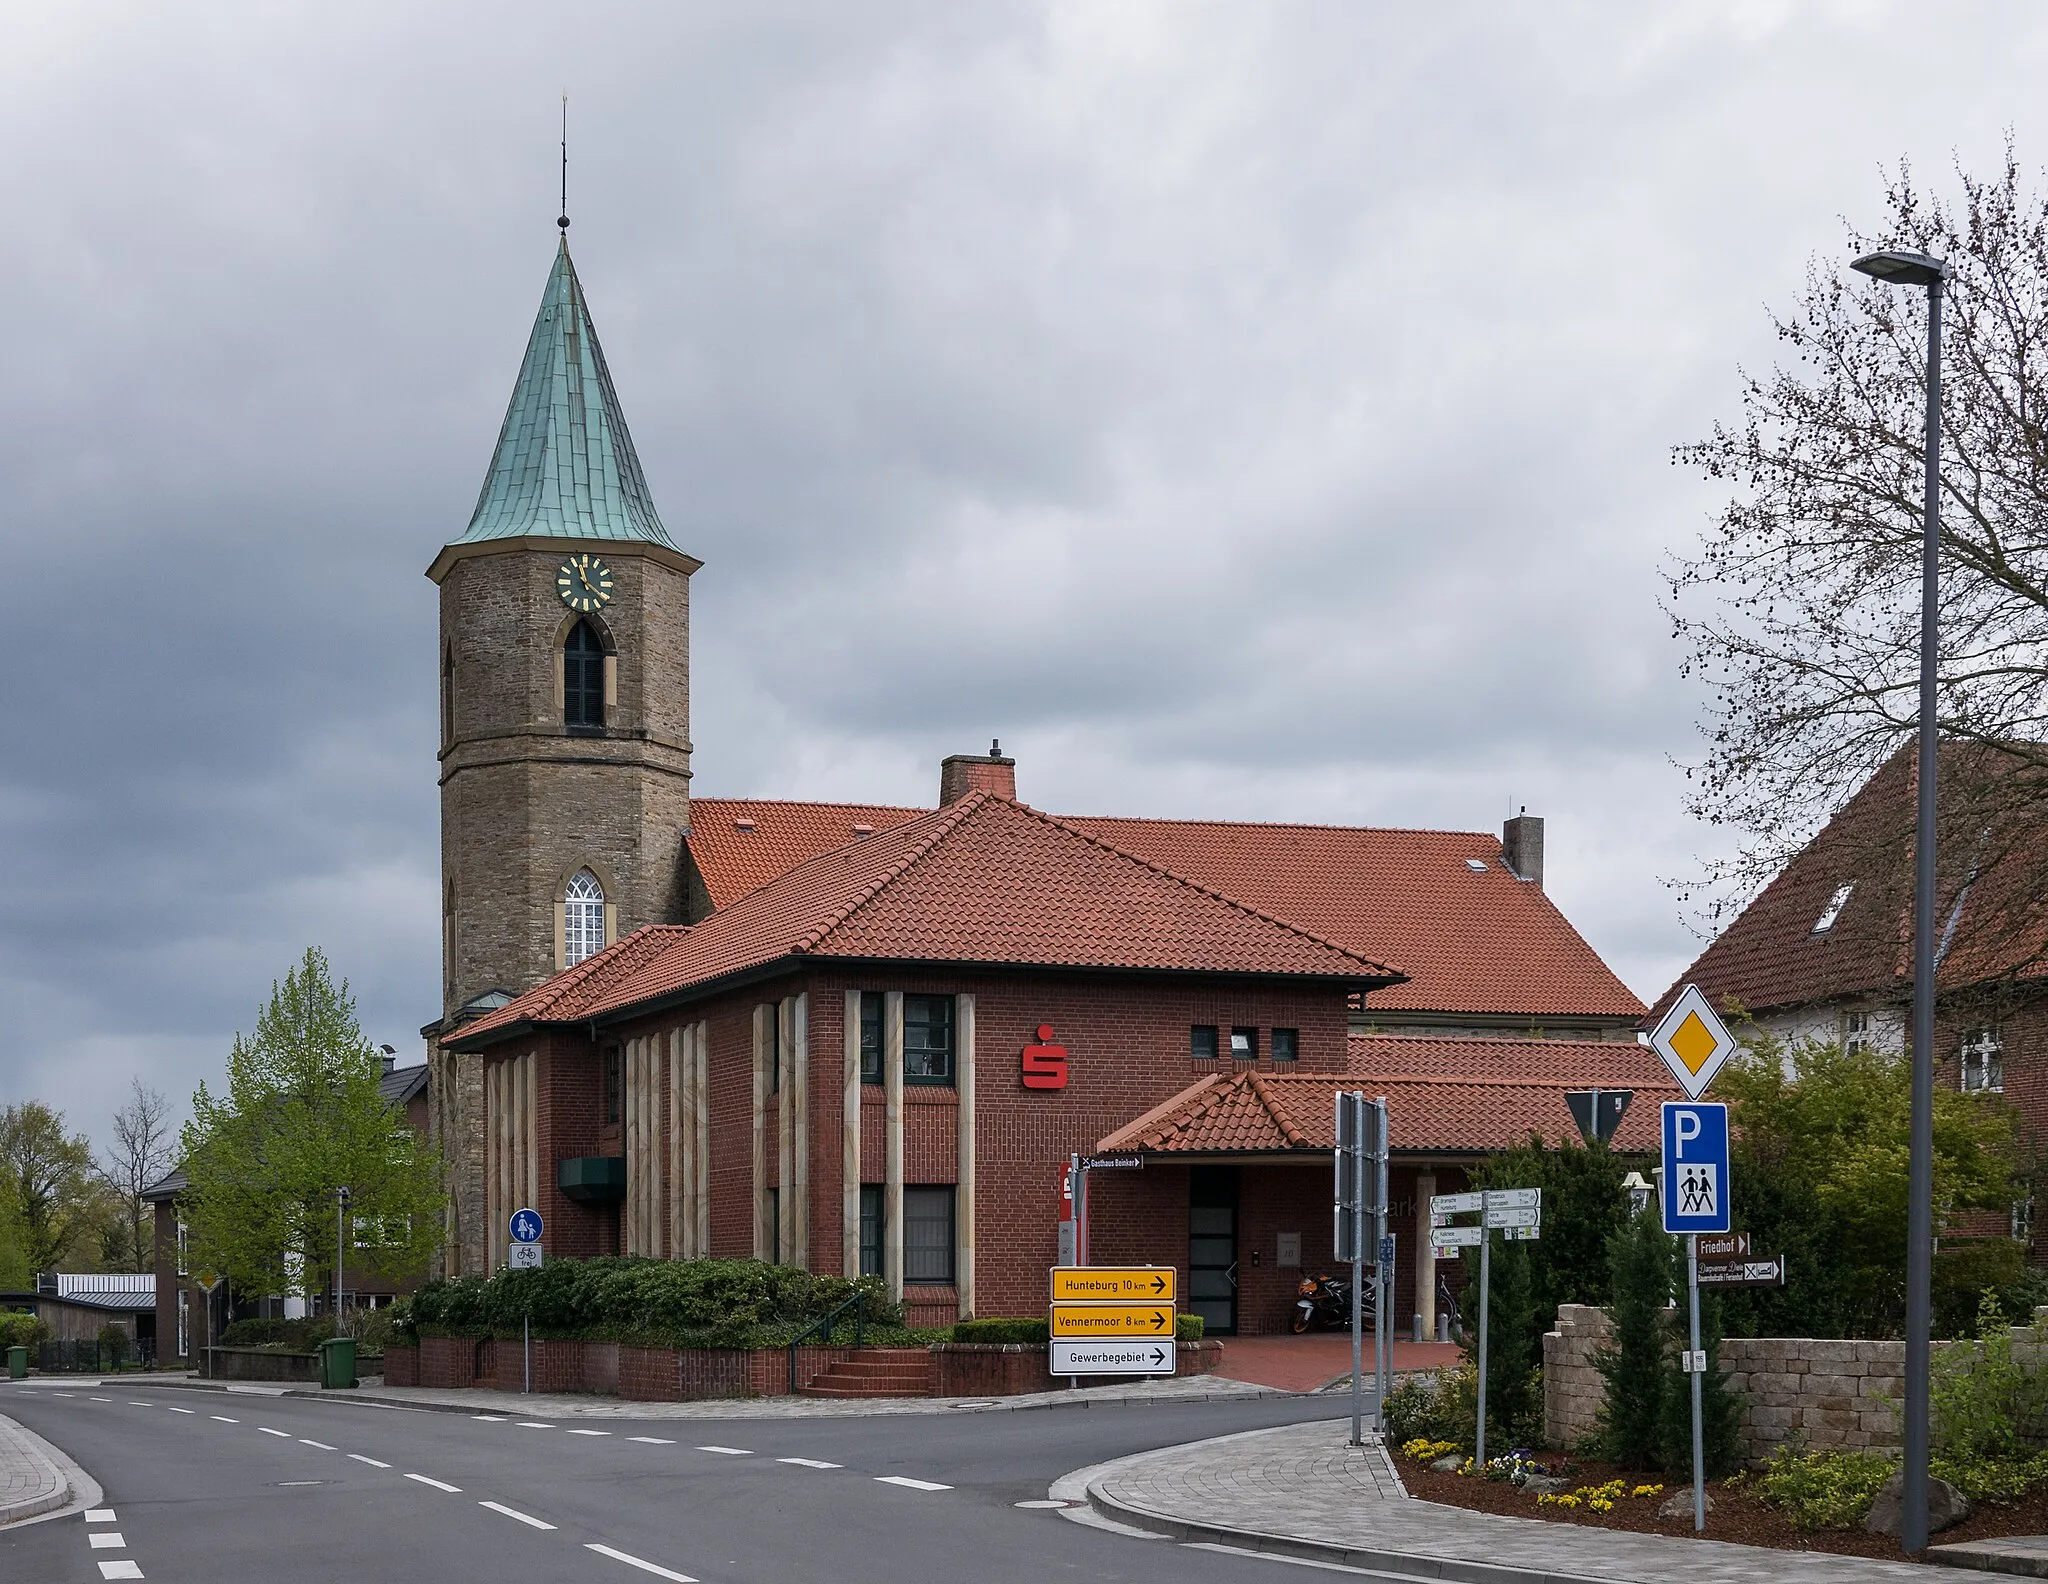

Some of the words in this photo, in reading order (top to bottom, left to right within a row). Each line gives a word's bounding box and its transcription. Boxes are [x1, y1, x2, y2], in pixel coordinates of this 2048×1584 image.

[1675, 1110, 1701, 1159] P
[1090, 1159, 1114, 1168] Gasthaus
[1388, 1195, 1417, 1217] ark
[1701, 1239, 1735, 1254] Friedhof
[1065, 1280, 1118, 1293] Hunteburg
[1122, 1280, 1132, 1290] 10
[1134, 1282, 1146, 1290] km
[1059, 1316, 1121, 1327] Vennermoor
[1125, 1316, 1132, 1326] 8
[1070, 1352, 1145, 1365] Gewerbegebiet
